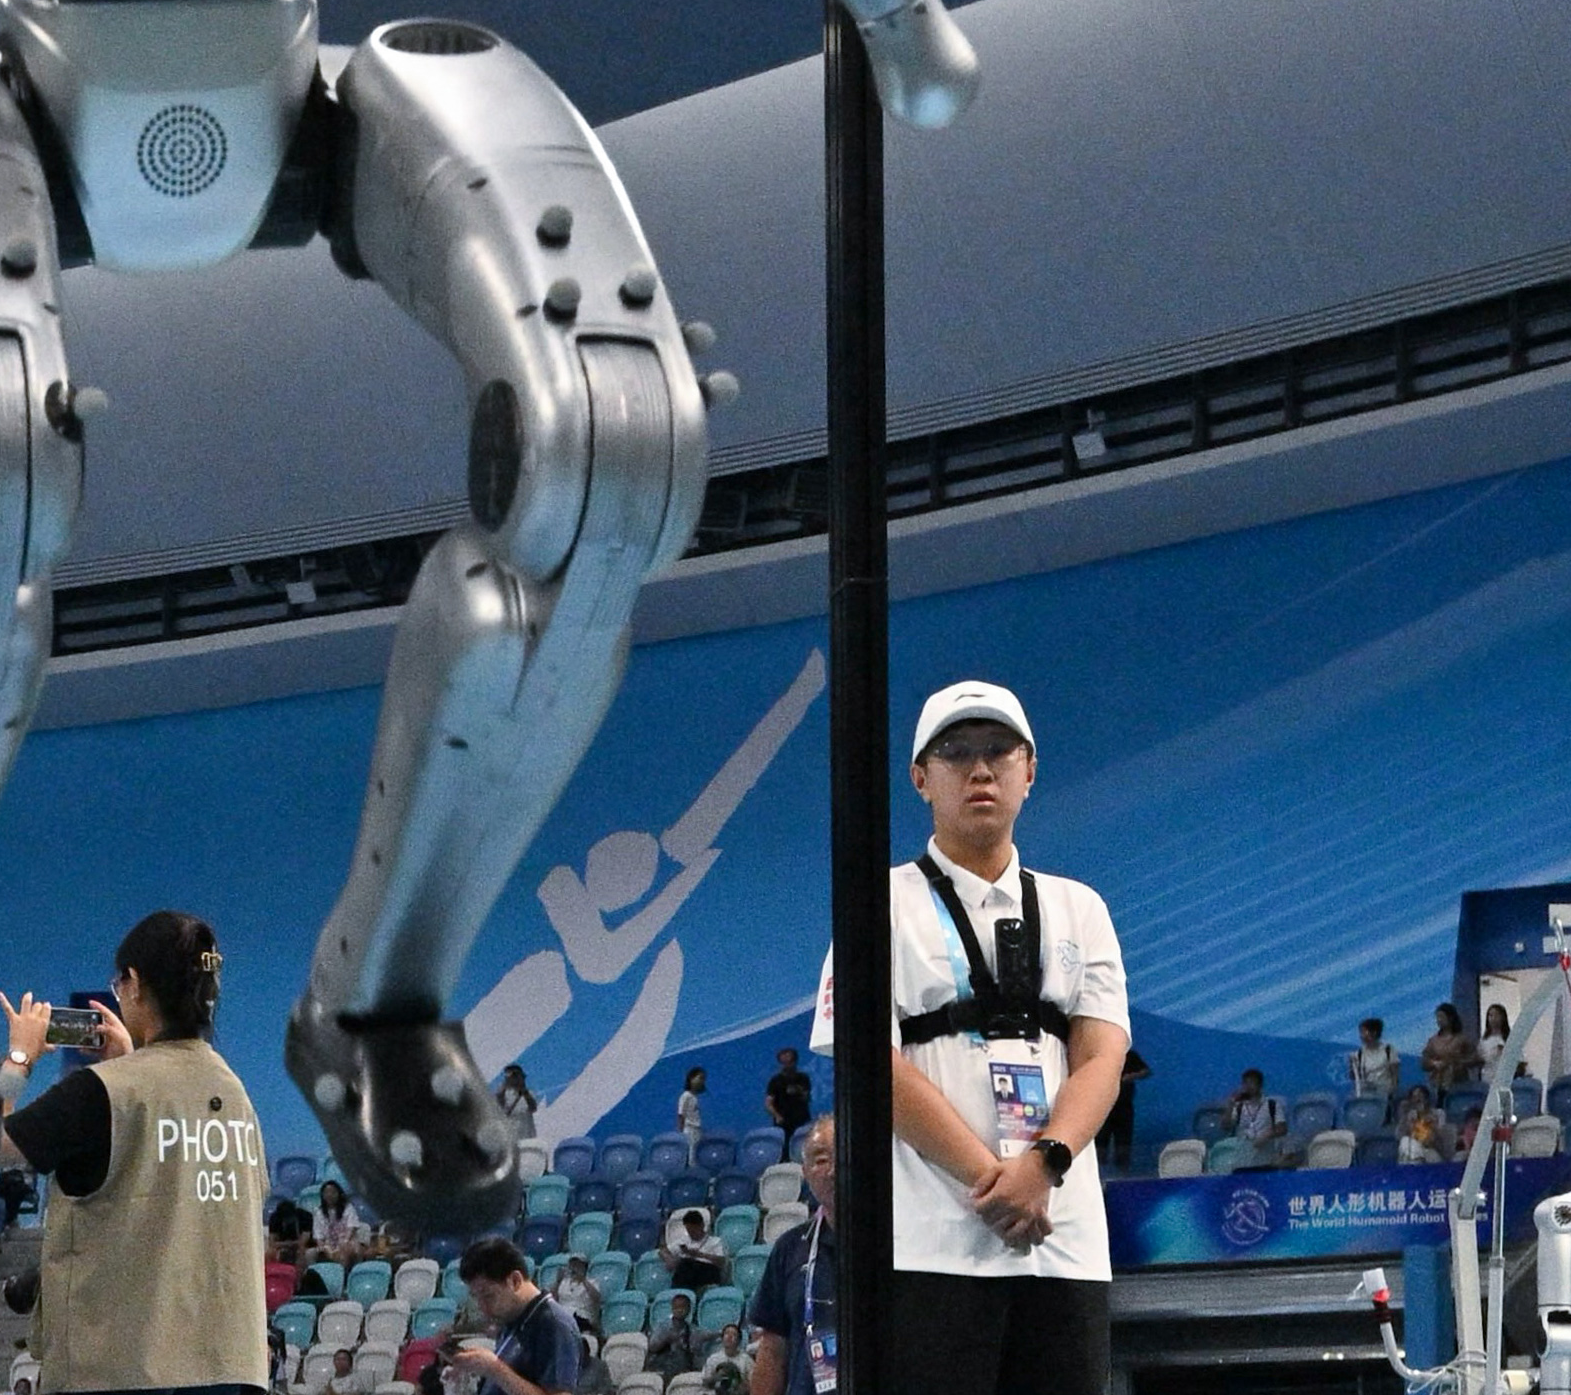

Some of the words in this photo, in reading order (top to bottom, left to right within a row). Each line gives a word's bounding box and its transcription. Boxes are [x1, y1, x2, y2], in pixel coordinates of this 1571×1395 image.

[196, 1170, 238, 1202] 051
[1289, 1218, 1309, 1231] The
[1312, 1217, 1346, 1229] World
[1349, 1215, 1408, 1227] Humanoid
[1410, 1213, 1445, 1224] Robot
